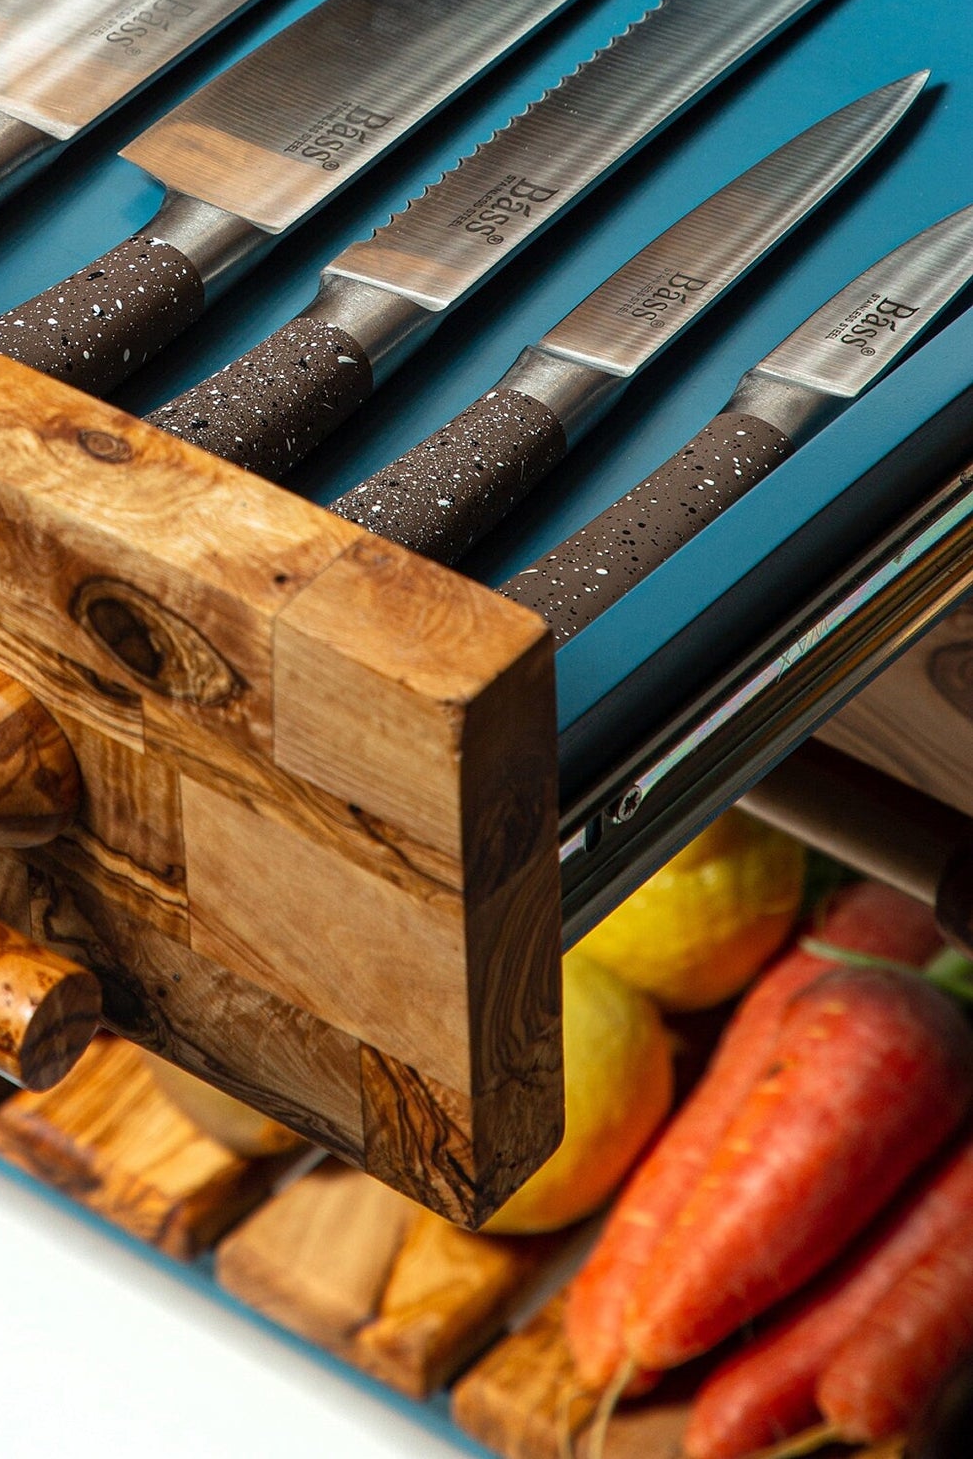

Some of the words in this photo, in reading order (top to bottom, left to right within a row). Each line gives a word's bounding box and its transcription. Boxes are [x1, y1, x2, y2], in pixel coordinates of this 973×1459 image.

[283, 133, 313, 153] STEEL
[473, 174, 517, 209] STAINLESS
[447, 208, 476, 228] STEEL
[844, 292, 881, 323] STAINLESS
[825, 322, 849, 339] STEEL
